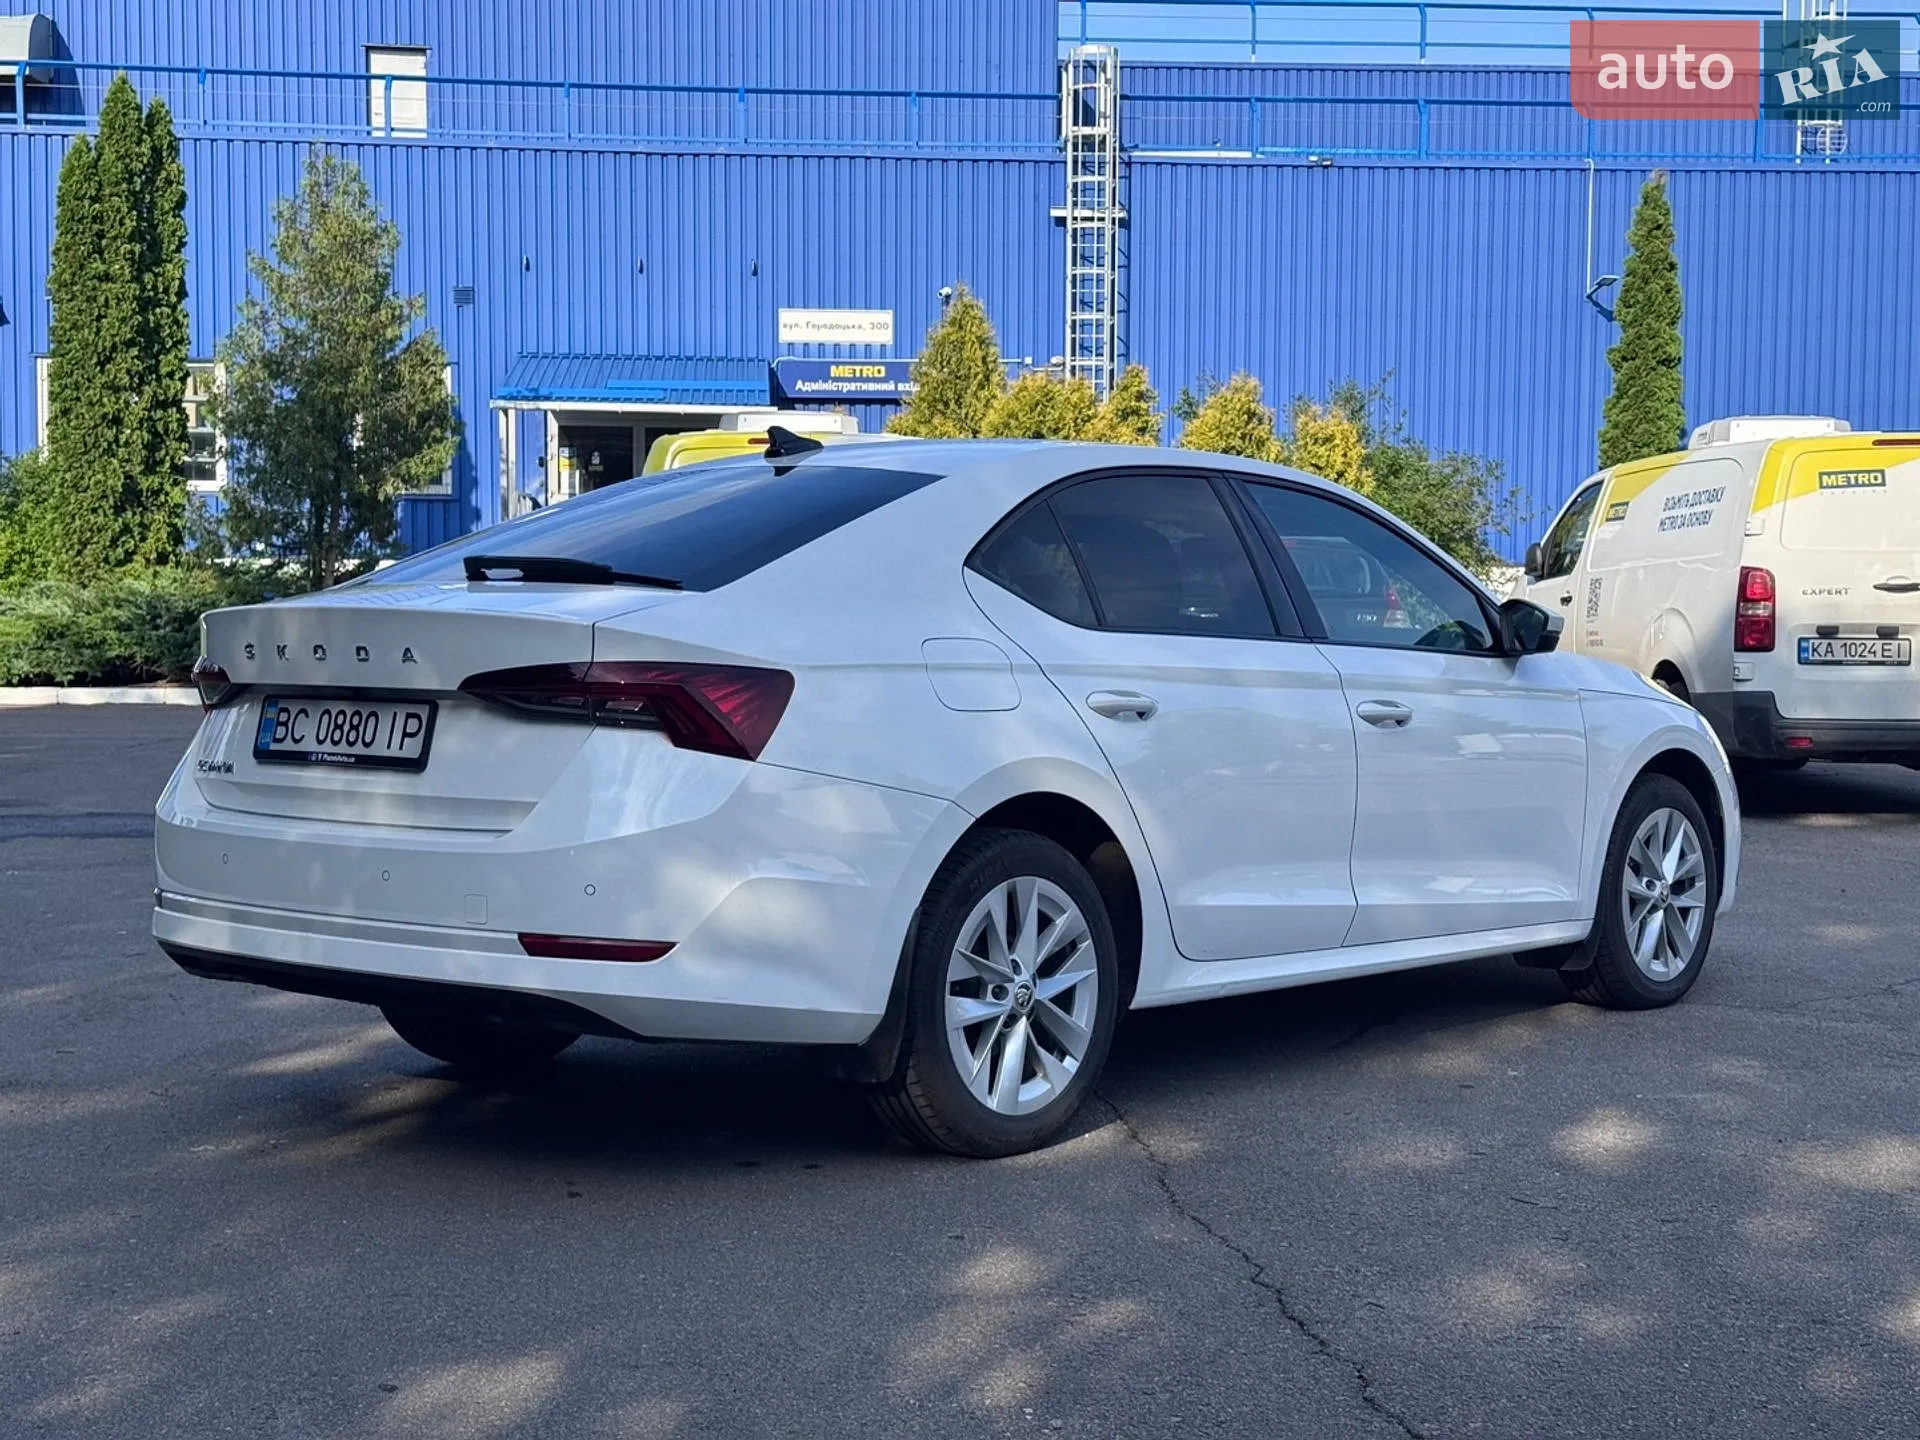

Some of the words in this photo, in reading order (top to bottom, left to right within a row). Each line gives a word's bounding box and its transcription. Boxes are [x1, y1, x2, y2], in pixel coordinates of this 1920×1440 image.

[783, 322, 802, 332] вул.
[869, 322, 889, 330] 300
[830, 365, 886, 377] METRO
[795, 380, 895, 392] Адміністративний
[1822, 472, 1882, 486] METRO
[1802, 588, 1851, 596] EXPERT
[1811, 642, 1835, 658] KA
[1840, 642, 1877, 658] 1024
[1881, 643, 1902, 659] EI
[272, 706, 309, 745] BC
[315, 708, 380, 748] 0880
[386, 711, 423, 751] IP
